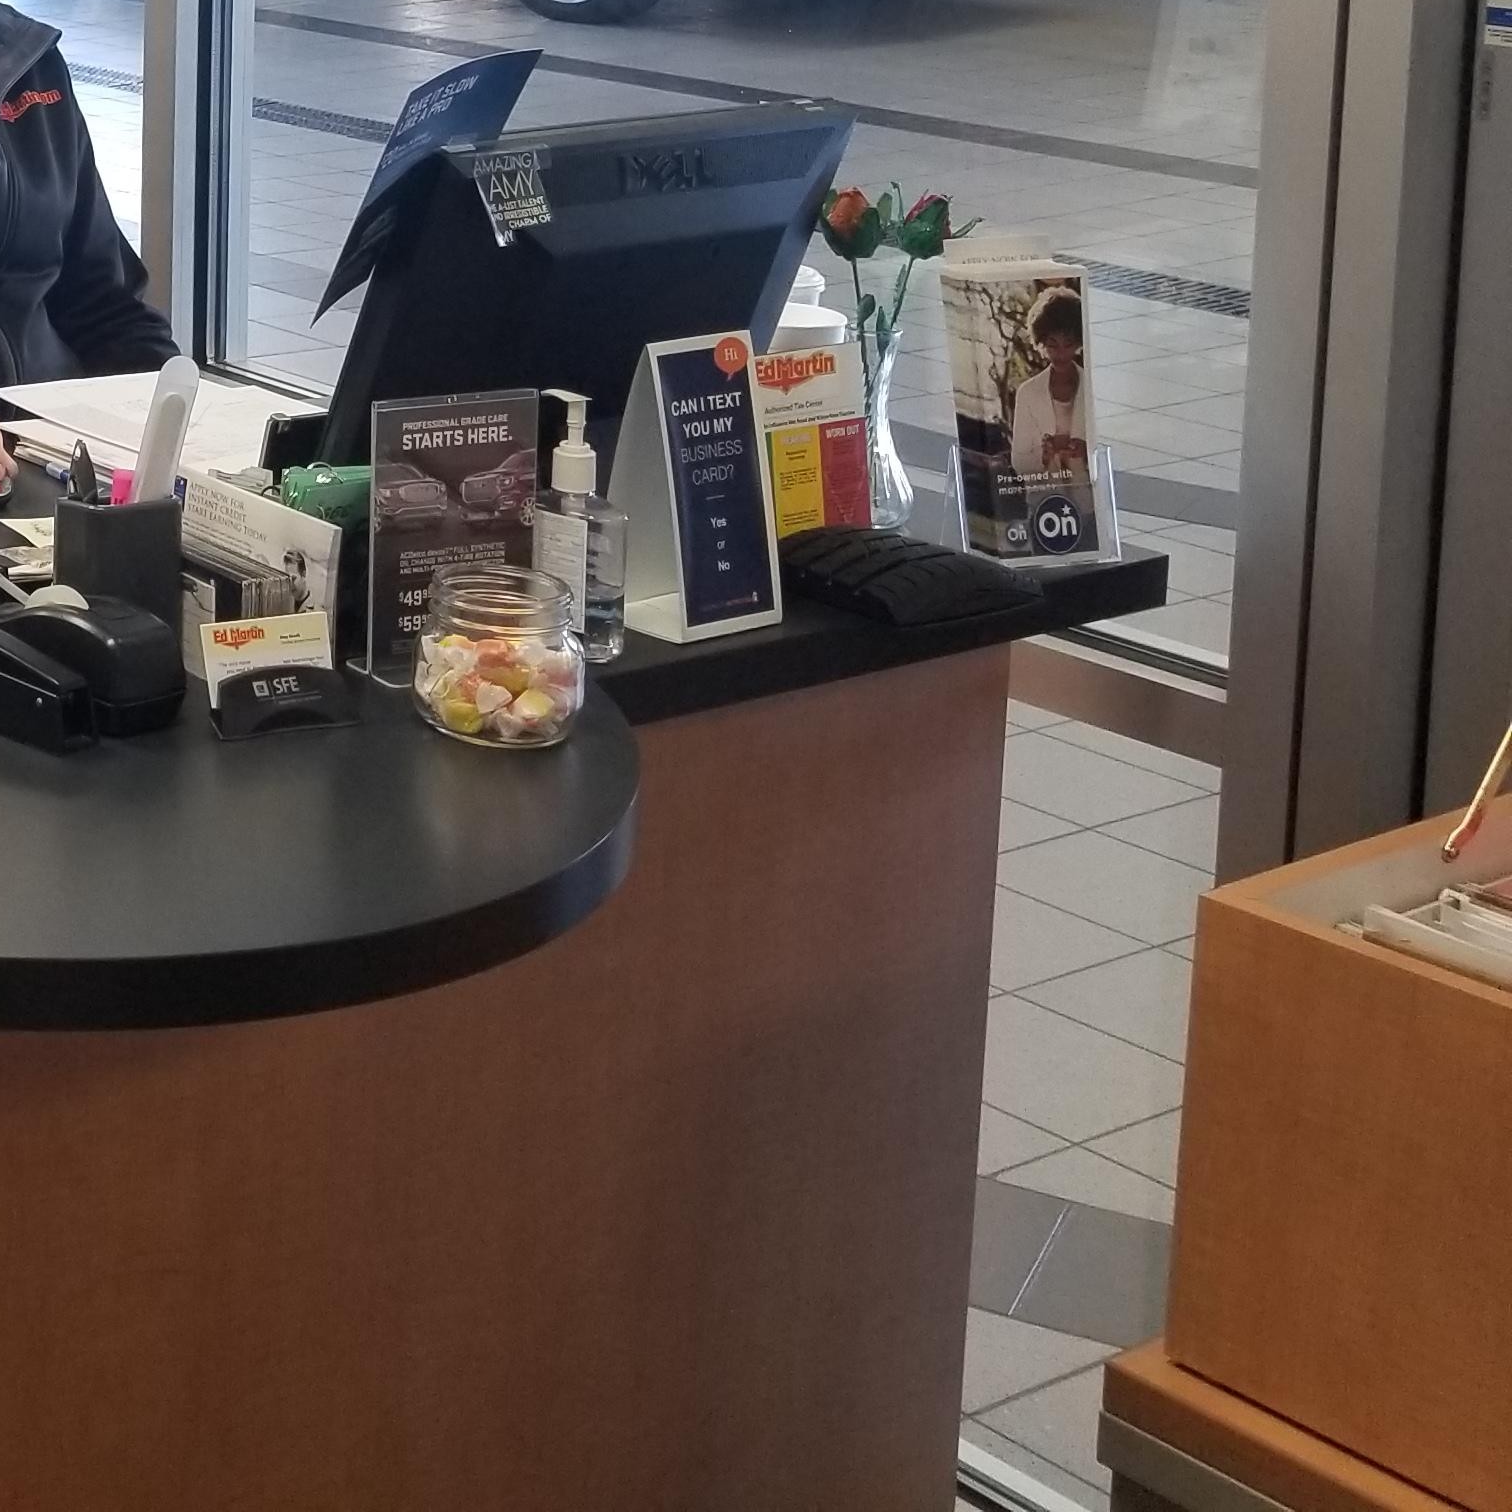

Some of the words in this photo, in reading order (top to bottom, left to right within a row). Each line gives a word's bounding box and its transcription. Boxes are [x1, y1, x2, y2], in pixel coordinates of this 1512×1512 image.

[441, 75, 480, 98] SLOW
[473, 152, 532, 177] AMAZING
[490, 169, 535, 201] AMY
[518, 195, 545, 208] TALENT
[538, 213, 551, 223] OF
[724, 347, 738, 362] Hi
[671, 398, 697, 417] CAN
[700, 397, 705, 413] I
[706, 391, 741, 411] TEXT
[402, 418, 460, 431] PROFESSIONAL
[461, 415, 486, 426] GRADE
[488, 413, 509, 423] CARE
[682, 420, 710, 438] YOU
[714, 416, 734, 434] MY
[825, 426, 845, 439] WORN
[846, 423, 860, 436] OUT
[402, 429, 464, 450] STARTS
[468, 425, 513, 445] HERE.
[680, 439, 744, 463] BUSINESS
[692, 463, 735, 486] CARD?
[997, 470, 1049, 484] Pre-owned
[1051, 468, 1073, 479] with
[710, 517, 727, 529] Yes
[1038, 511, 1078, 538] On
[1007, 527, 1028, 541] On
[717, 540, 726, 550] or
[718, 560, 731, 571] No
[273, 676, 299, 694] SFE
